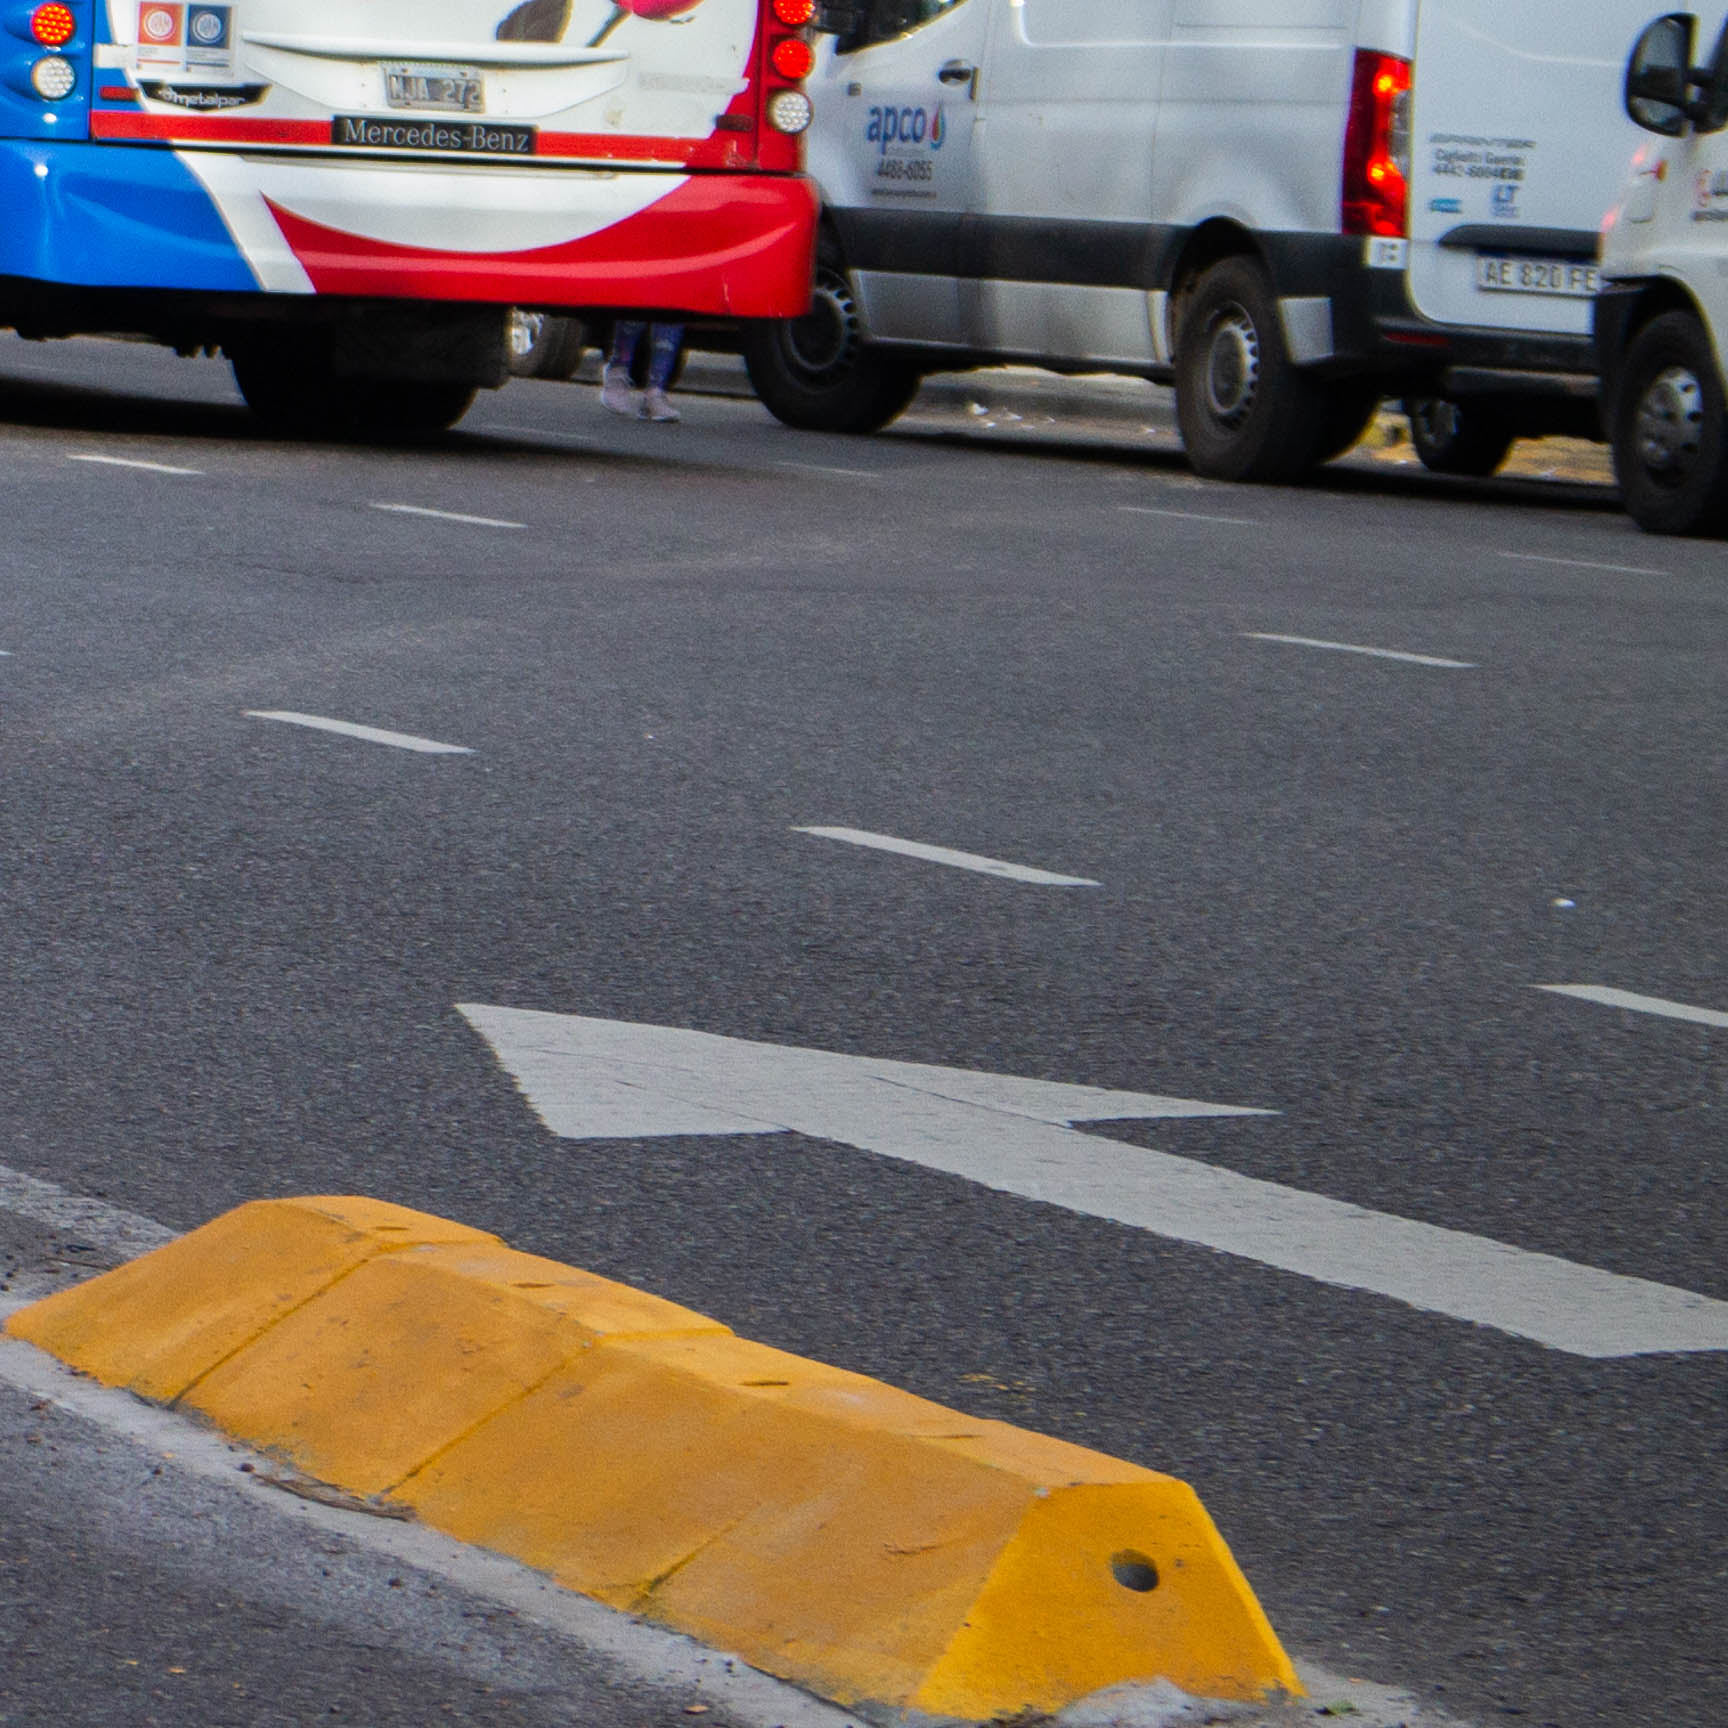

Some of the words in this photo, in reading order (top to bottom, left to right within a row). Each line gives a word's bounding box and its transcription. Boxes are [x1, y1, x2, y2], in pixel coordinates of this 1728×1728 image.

[174, 92, 247, 108] metalpar
[389, 74, 430, 101] NJA
[442, 78, 481, 104] 272
[344, 118, 529, 153] Mercedes-Benz
[867, 106, 928, 155] apco
[1485, 262, 1513, 286] AE
[1520, 263, 1562, 289] 820
